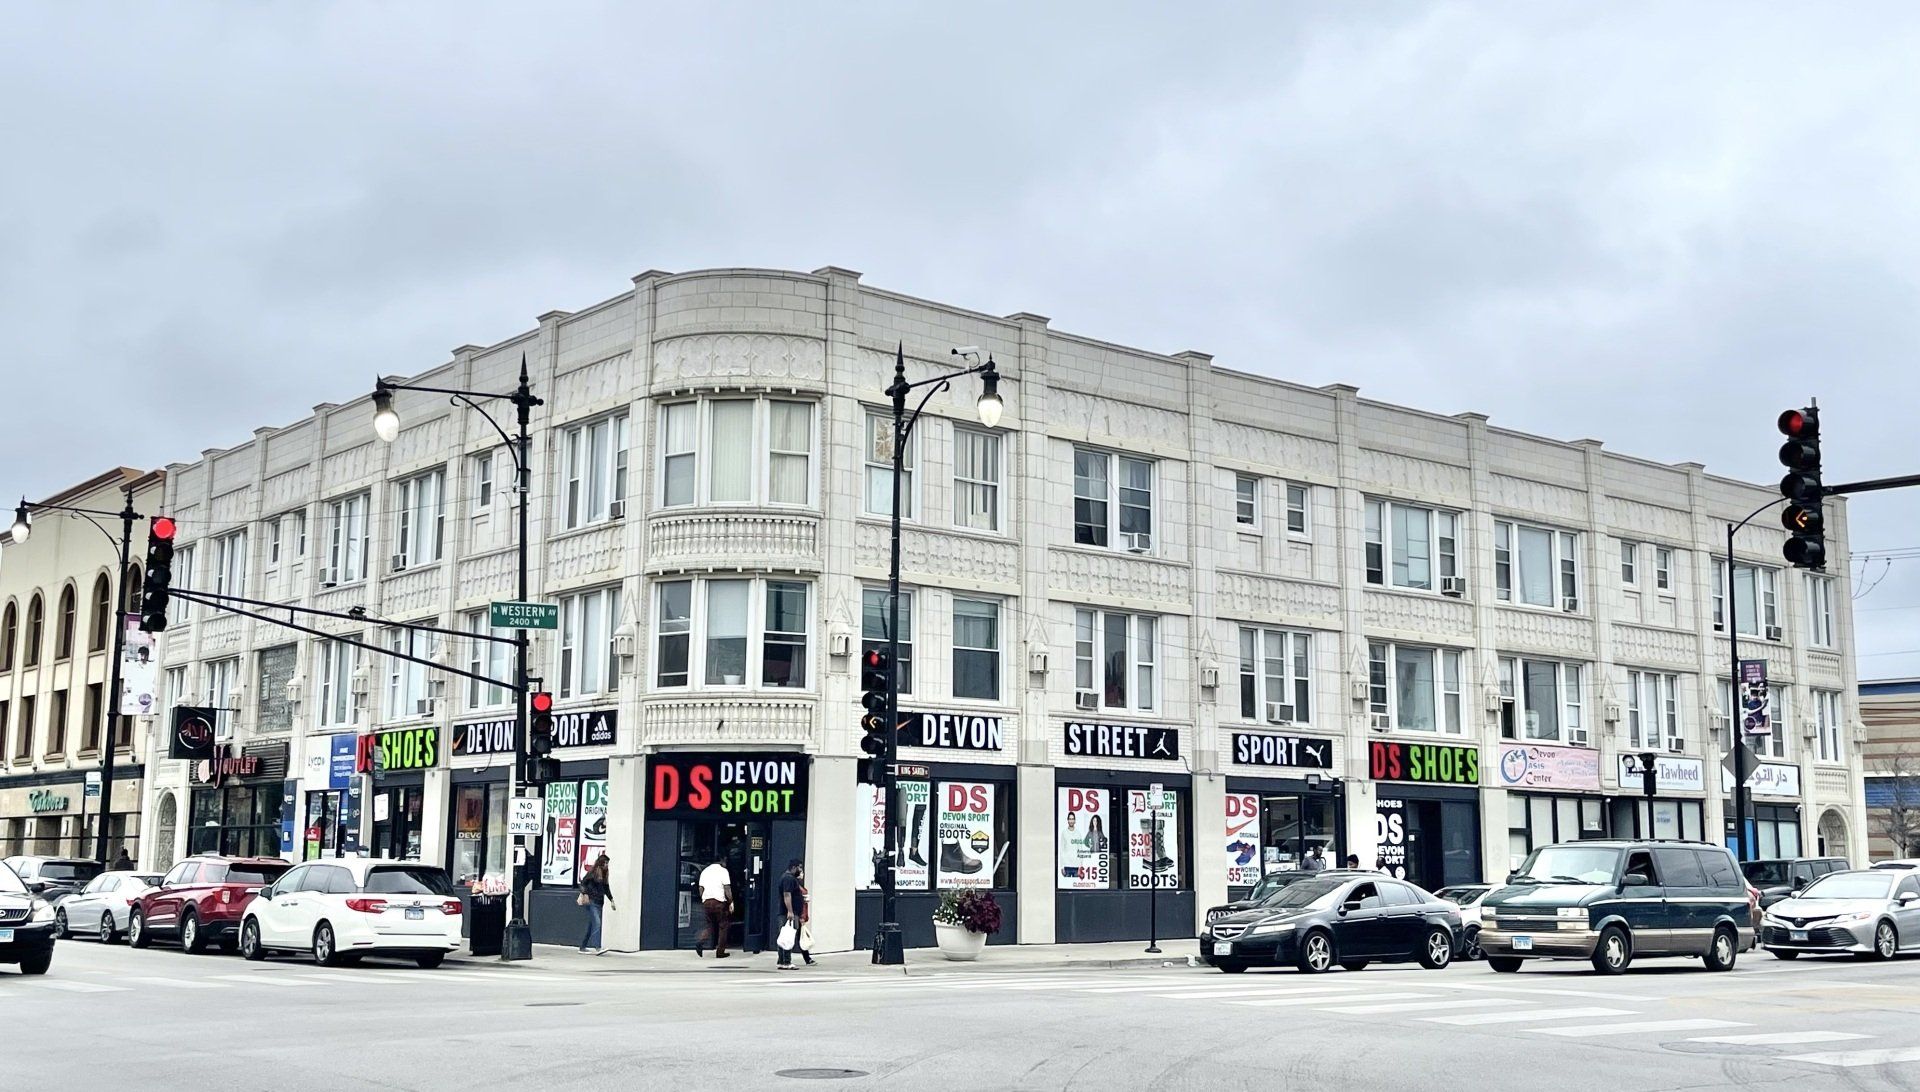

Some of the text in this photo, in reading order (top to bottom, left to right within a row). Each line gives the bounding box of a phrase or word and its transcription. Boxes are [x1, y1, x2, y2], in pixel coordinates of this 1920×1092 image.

[492, 606, 498, 614] N
[501, 605, 545, 617] WESTERN
[509, 617, 530, 626] 2400
[467, 713, 590, 754] DEVON PORT
[591, 730, 612, 741] adidas
[922, 714, 1003, 749] DEVON
[1068, 723, 1148, 757] STREET
[357, 734, 376, 773] DS
[382, 728, 435, 769] SHOES
[1238, 734, 1300, 765] SPORT
[1528, 747, 1556, 760] Devon
[222, 756, 257, 774] OUTLET
[1373, 742, 1478, 782] DS SHOES
[720, 761, 796, 785] DEVON
[1526, 771, 1552, 785] Center
[1659, 763, 1699, 781] Tawheed
[547, 783, 577, 798] DEVON
[586, 781, 608, 806] DS
[654, 764, 713, 810] DS
[720, 789, 794, 813] SPORT
[948, 784, 988, 813] DS
[1068, 788, 1100, 813] DS
[1147, 792, 1176, 801] DON
[519, 802, 533, 810] NO
[546, 799, 576, 814] SPORT
[1226, 795, 1258, 818] DS
[1377, 800, 1403, 809] HOES
[515, 812, 536, 820] TURN
[942, 812, 990, 822] DEVON SPORT
[525, 822, 540, 831] RED
[940, 822, 968, 830] ORIGINAL
[1376, 813, 1404, 845] DS
[939, 829, 971, 839] BOOTS
[1131, 833, 1151, 848] $30
[556, 839, 572, 855] $30
[1131, 848, 1151, 858] SALE
[1378, 845, 1405, 856] EVON
[1098, 836, 1108, 883] HOODIES
[1079, 866, 1098, 881] $15
[1227, 867, 1241, 882] 55
[1241, 866, 1260, 874] WOMEN
[1130, 874, 1178, 888] BOOTS
